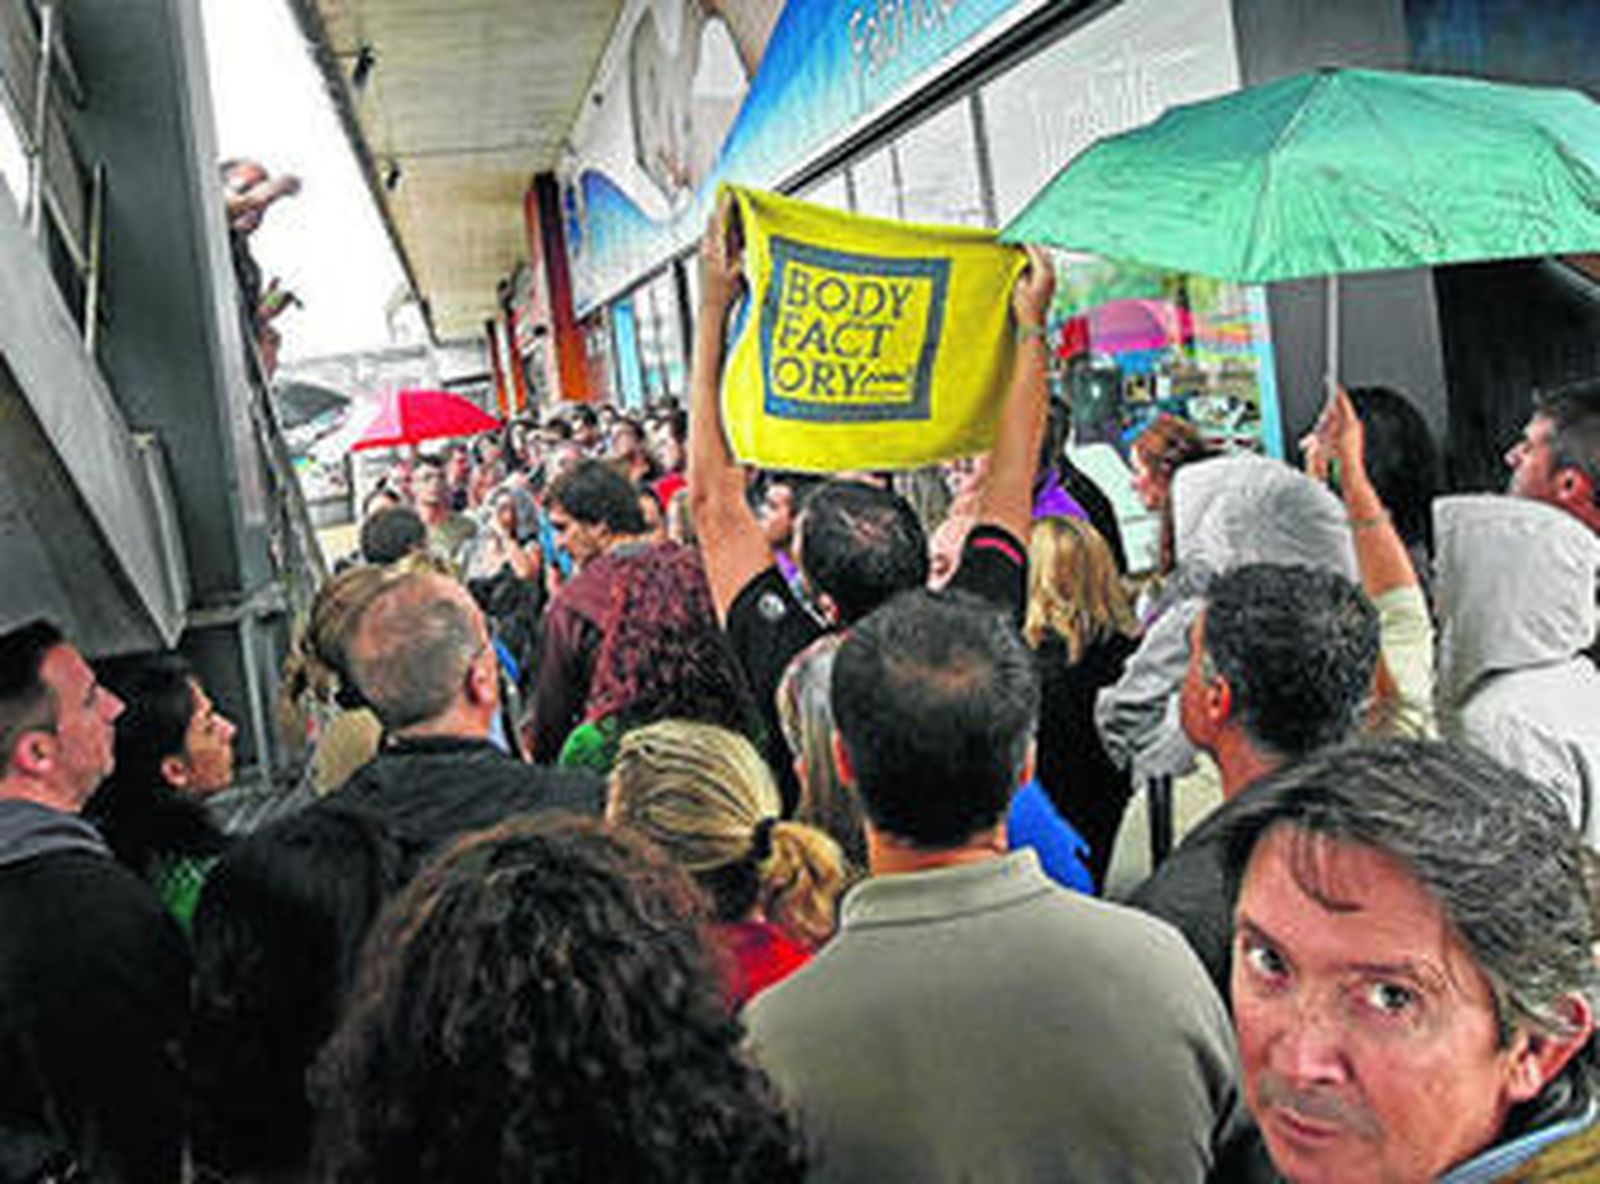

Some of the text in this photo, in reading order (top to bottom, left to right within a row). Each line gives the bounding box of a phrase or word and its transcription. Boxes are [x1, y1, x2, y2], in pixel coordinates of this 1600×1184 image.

[787, 268, 912, 318] BODY
[779, 312, 894, 358] FACT
[774, 356, 867, 398] ORY
